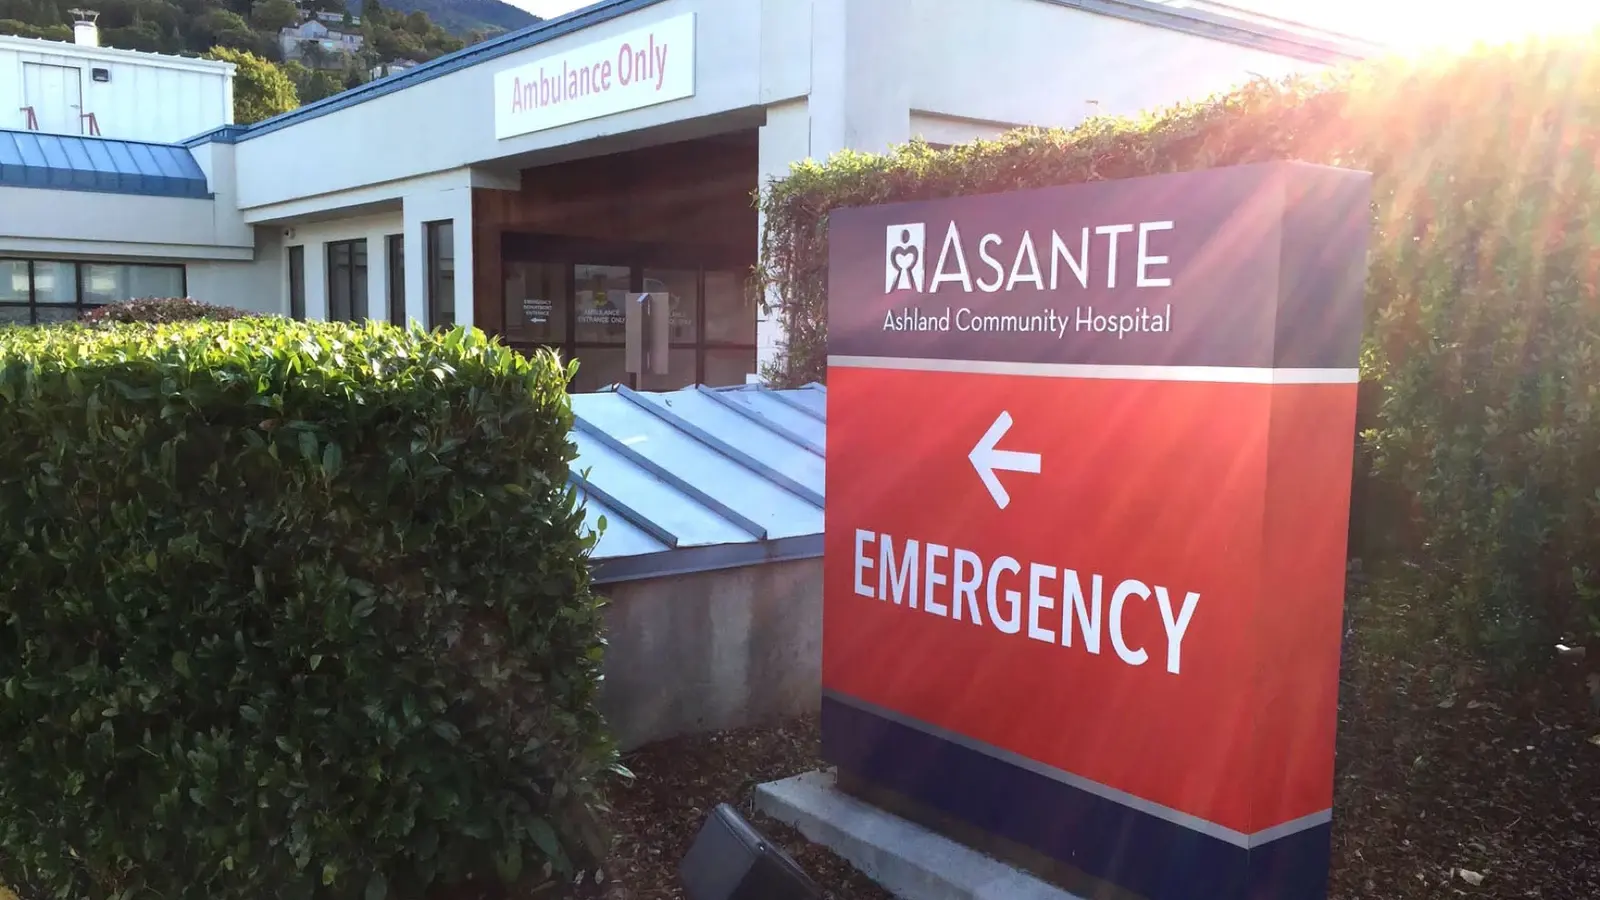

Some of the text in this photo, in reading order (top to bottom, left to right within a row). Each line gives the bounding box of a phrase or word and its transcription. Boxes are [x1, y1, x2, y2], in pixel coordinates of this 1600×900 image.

[512, 33, 667, 113] Ambulance Only
[929, 220, 1175, 293] ASANTE
[577, 316, 625, 324] ENTRANCE ONLY
[583, 308, 620, 316] AMBULANCE
[883, 304, 1171, 339] Ashland Community Hospital
[854, 528, 1200, 675] EMERGENCY
